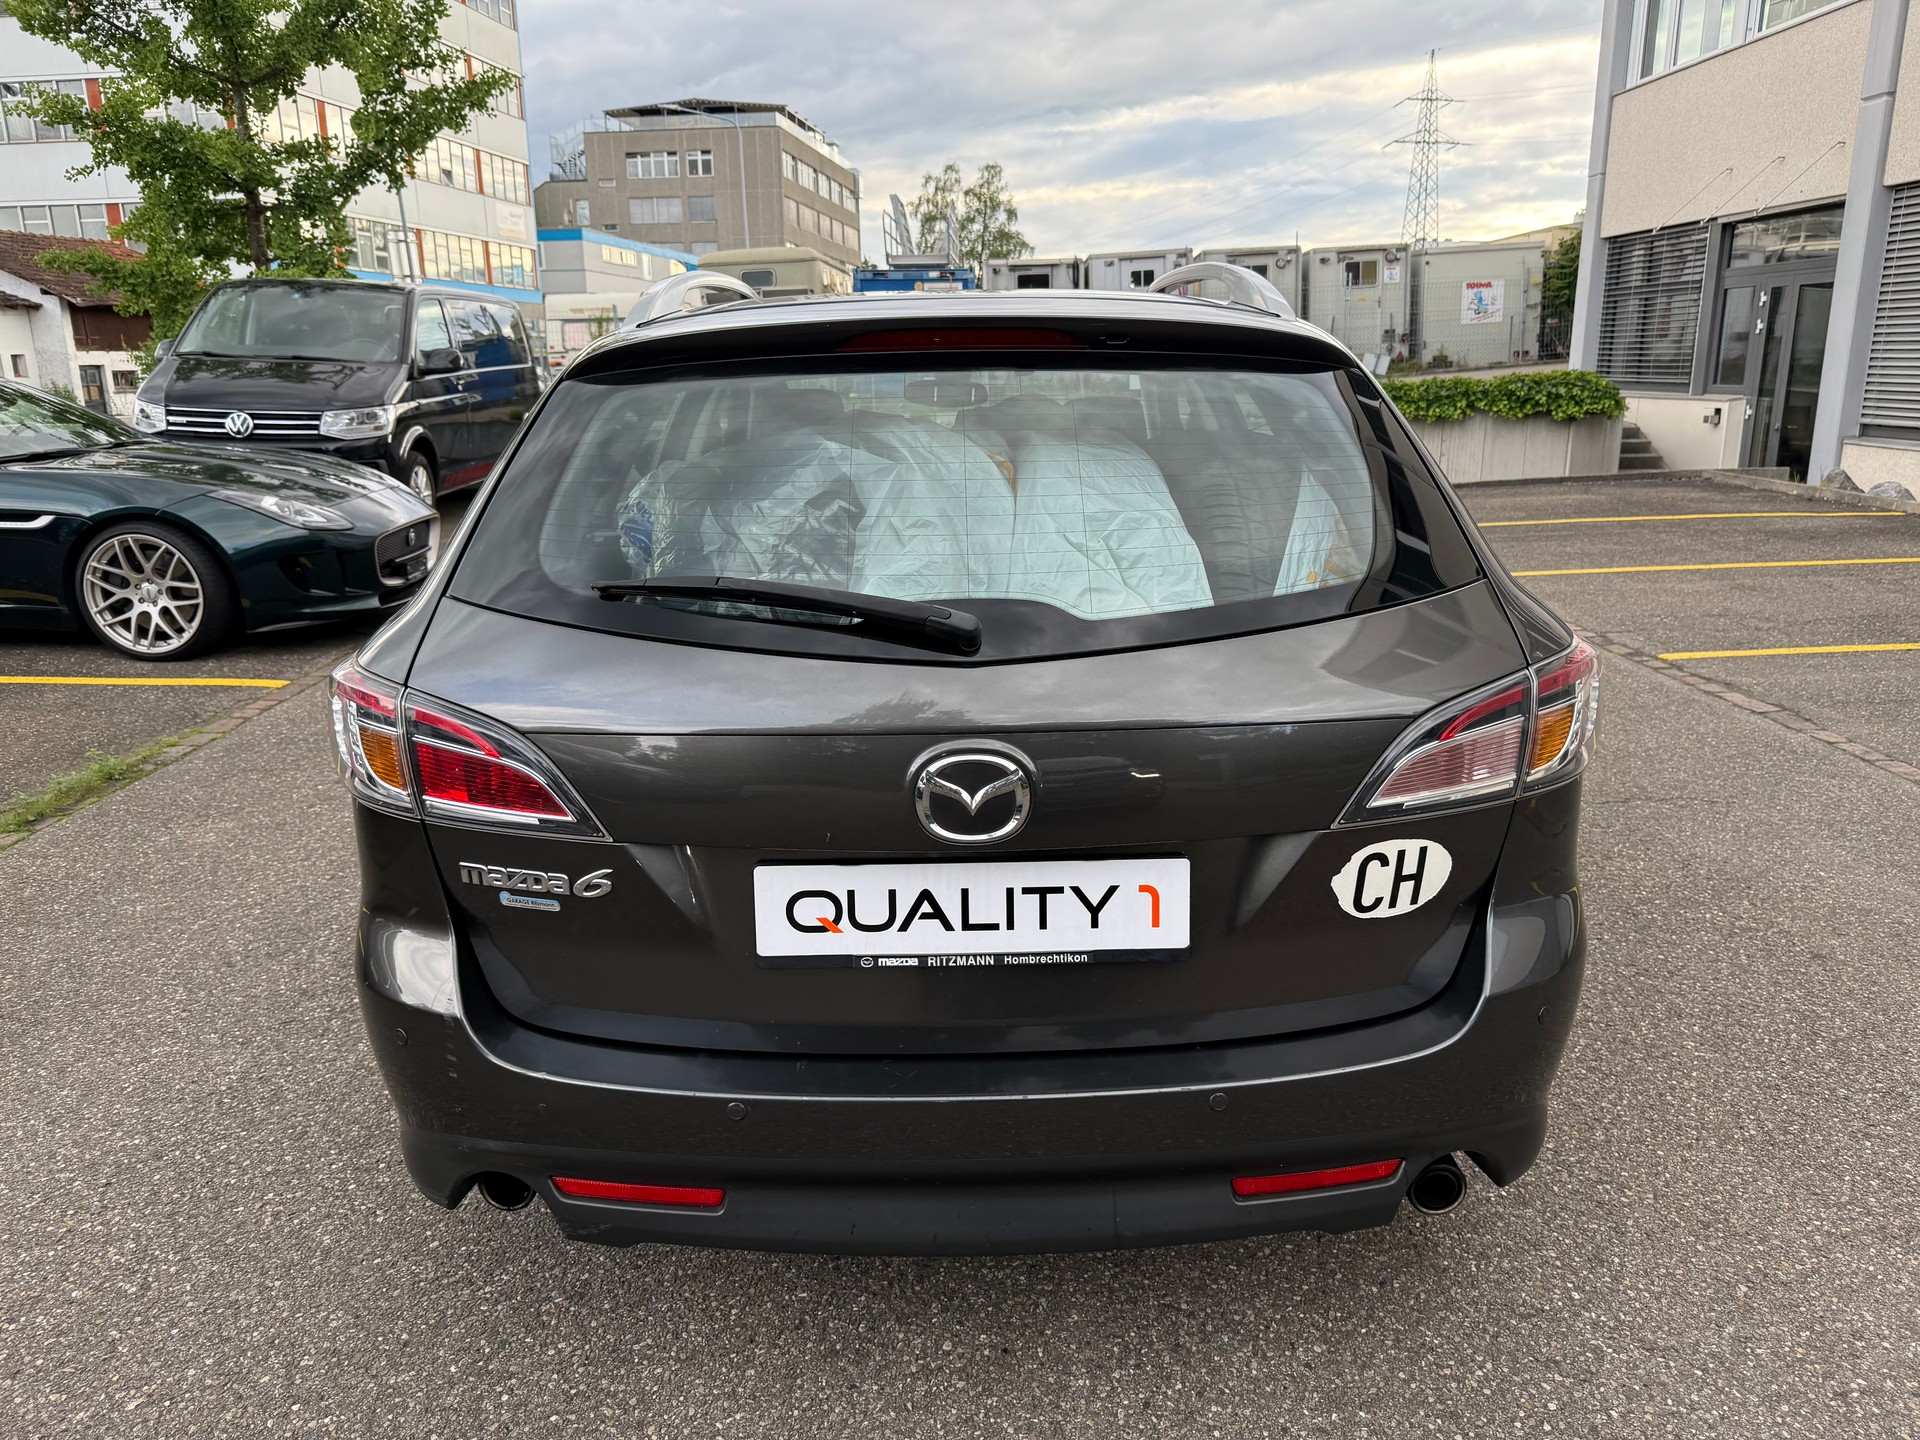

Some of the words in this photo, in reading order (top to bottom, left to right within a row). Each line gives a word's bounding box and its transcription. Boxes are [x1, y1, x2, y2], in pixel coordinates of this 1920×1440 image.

[1352, 846, 1429, 914] CH
[785, 884, 1121, 934] QUALITY
[1138, 883, 1160, 929] 1
[878, 957, 919, 967] mazda
[927, 955, 995, 967] RITZMANN
[1004, 953, 1088, 966] Hombrechtikon
